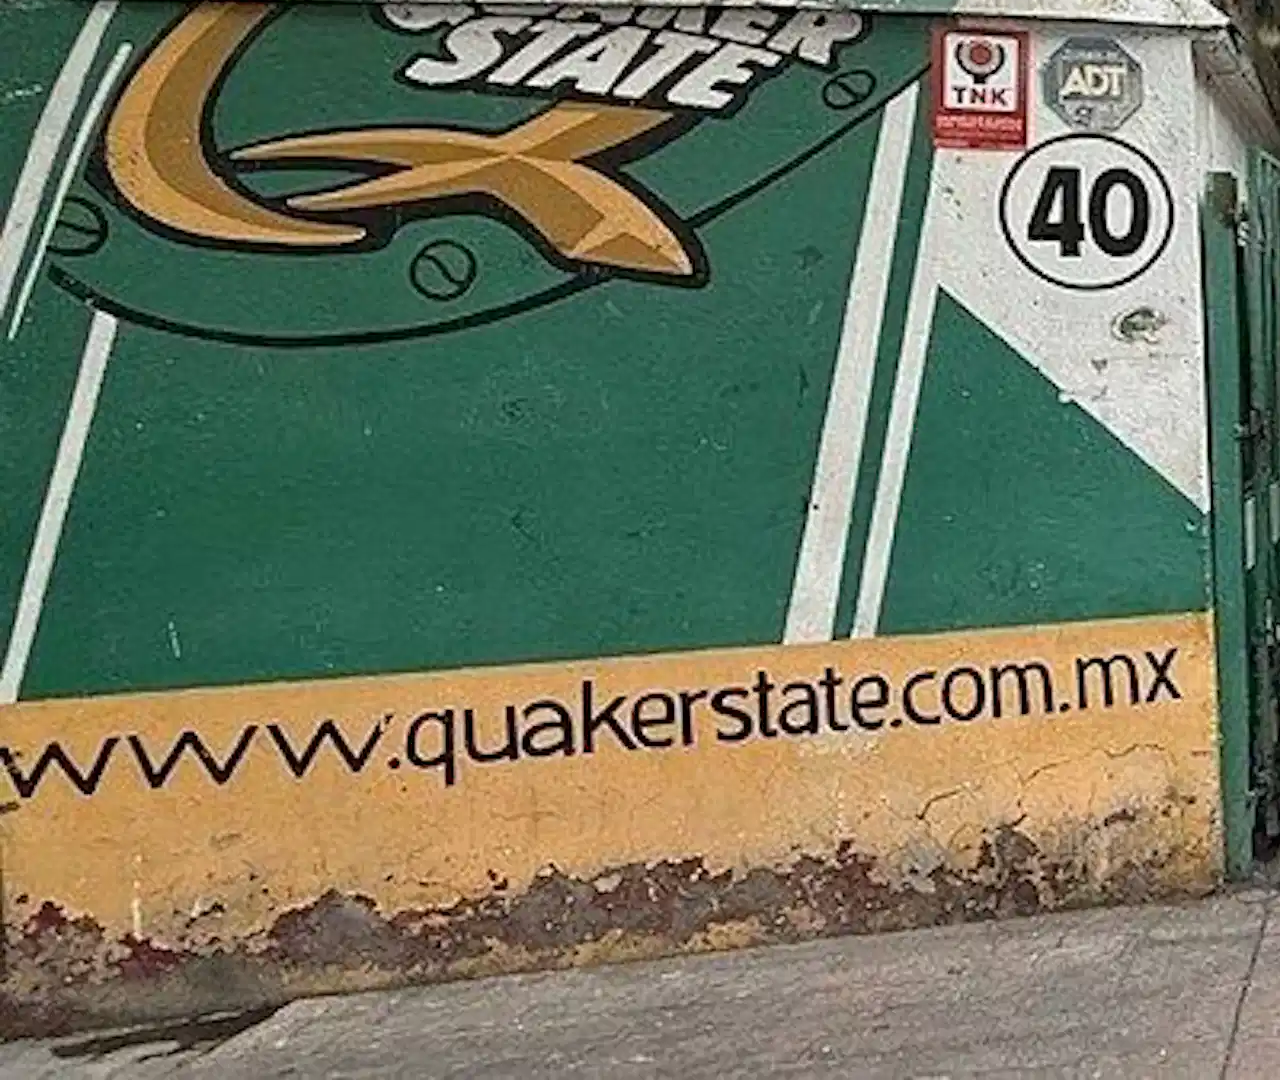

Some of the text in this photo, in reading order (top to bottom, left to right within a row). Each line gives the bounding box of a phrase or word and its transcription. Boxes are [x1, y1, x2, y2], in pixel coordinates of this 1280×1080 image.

[402, 16, 782, 110] STATE
[952, 86, 1009, 106] TNK
[1061, 64, 1128, 98] ADT
[1027, 167, 1150, 257] 40
[0, 645, 1179, 798] www.quakerstate.com.mx
